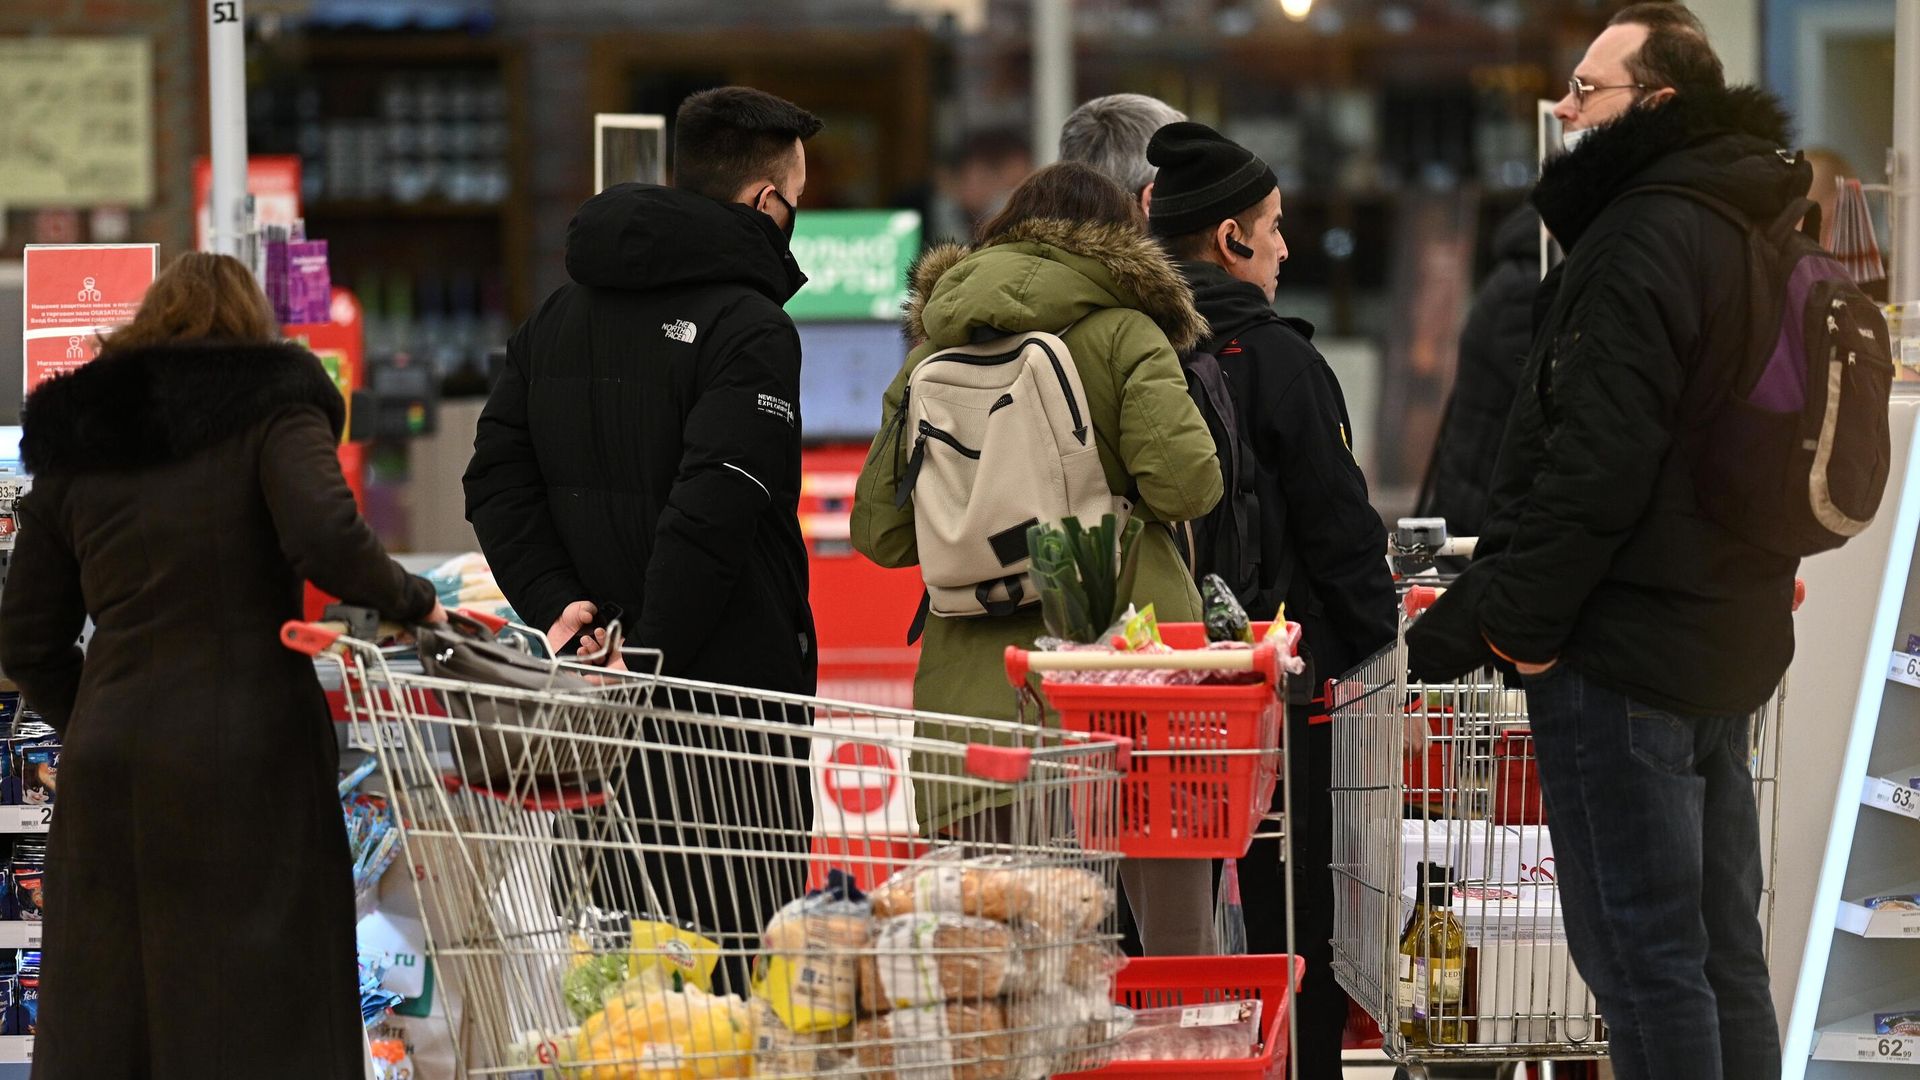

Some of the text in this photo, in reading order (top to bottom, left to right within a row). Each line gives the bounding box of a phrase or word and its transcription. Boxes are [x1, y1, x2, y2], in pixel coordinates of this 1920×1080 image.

[213, 2, 238, 23] 51
[661, 322, 687, 335] NORTH
[675, 319, 690, 328] THE
[665, 330, 683, 341] FACE
[758, 393, 778, 403] NEVER
[1892, 787, 1911, 806] 63
[1878, 1038, 1912, 1058] 62 99
